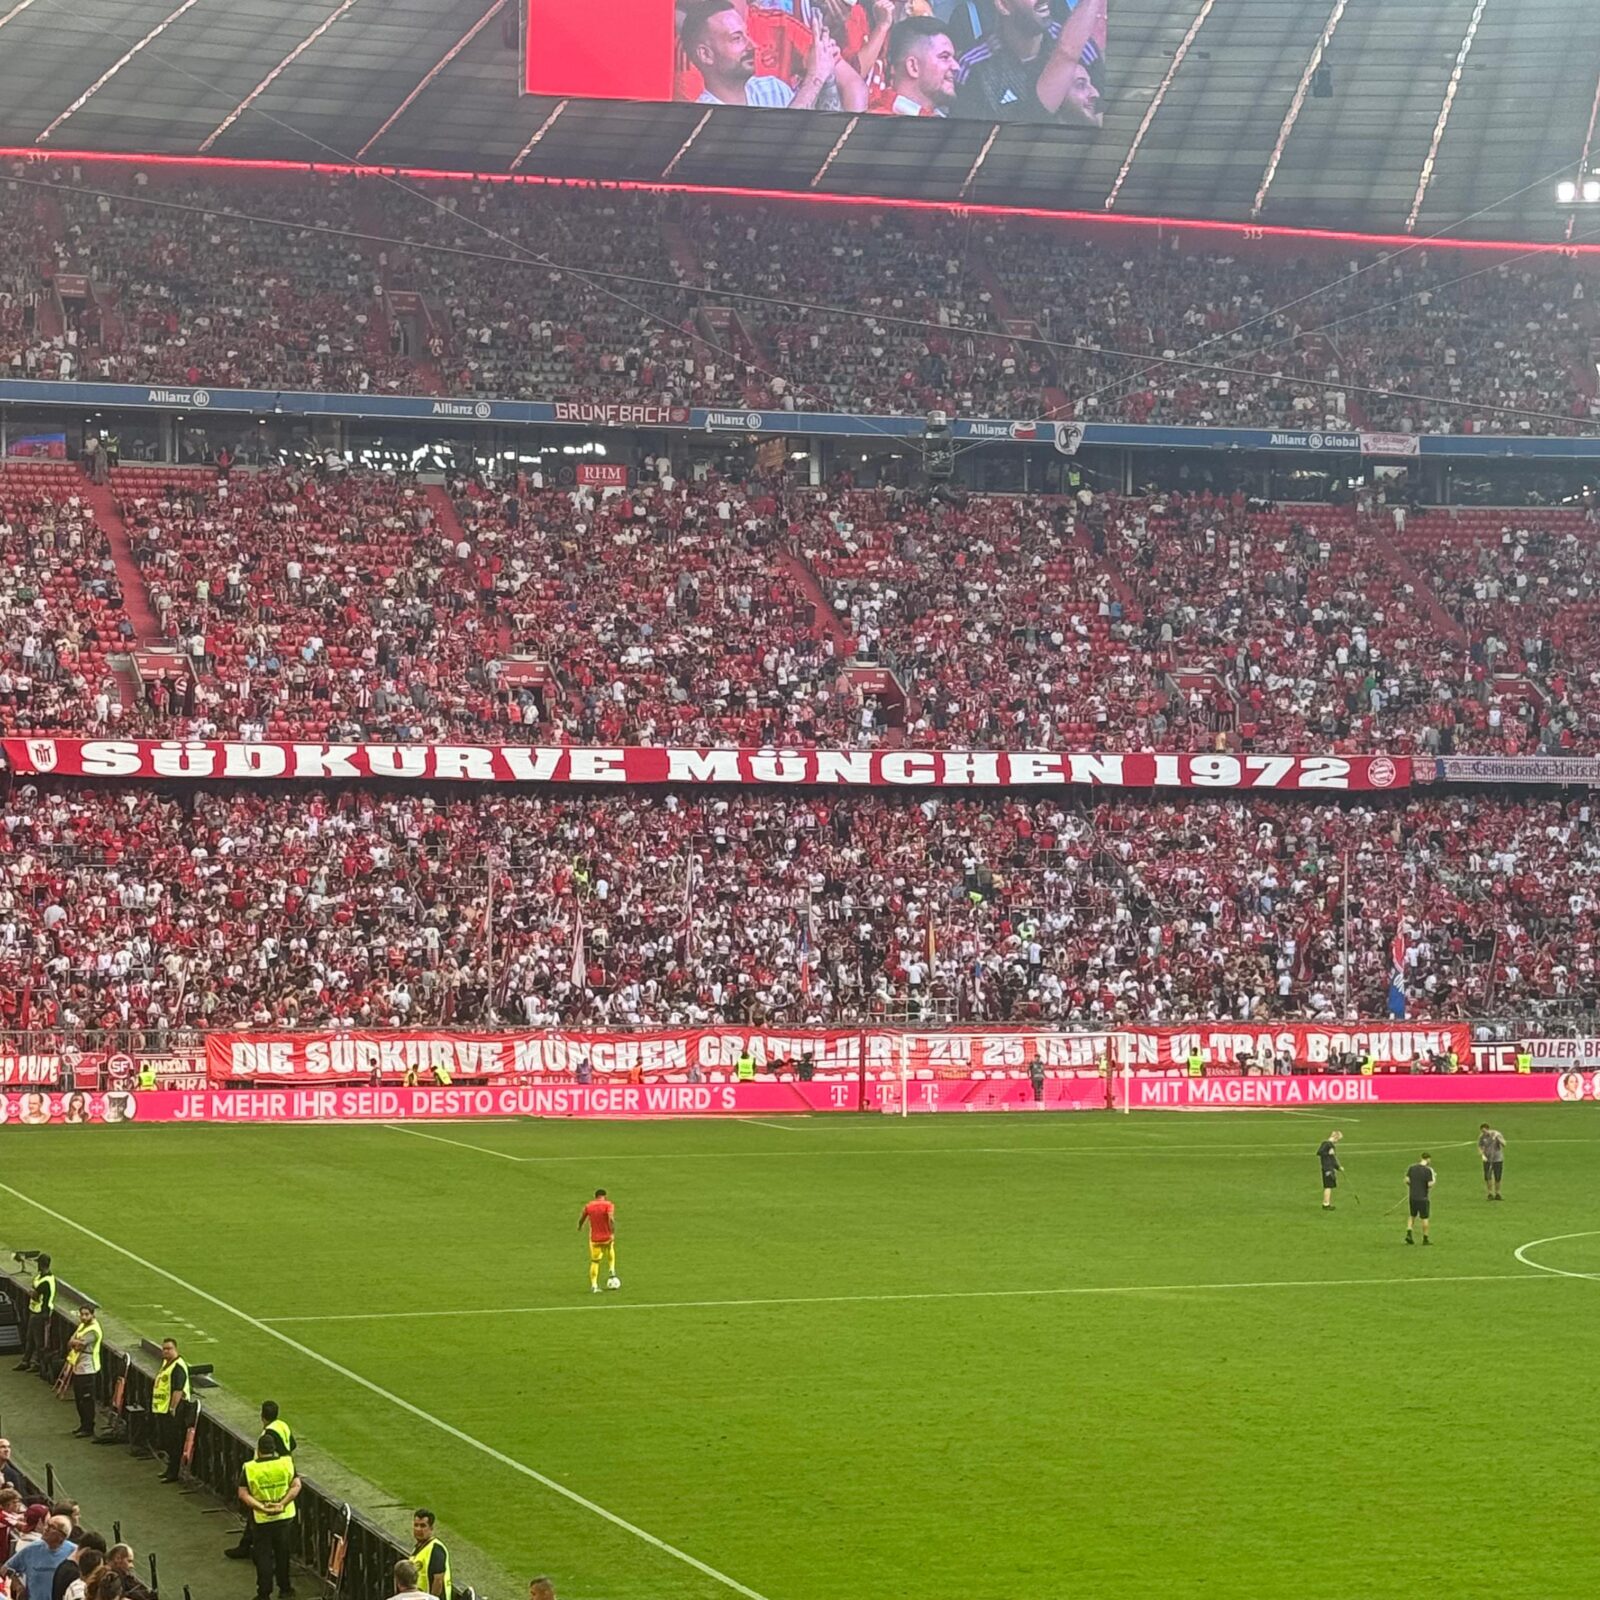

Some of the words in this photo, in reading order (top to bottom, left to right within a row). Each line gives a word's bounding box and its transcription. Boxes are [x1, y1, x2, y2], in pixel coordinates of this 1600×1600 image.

[148, 390, 191, 403] Allianz
[432, 402, 473, 416] Allianz
[706, 412, 745, 426] Allianz
[969, 423, 1008, 436] Allianz
[1270, 434, 1307, 447] Allianz
[1324, 434, 1359, 448] Global
[584, 466, 621, 480] RHM
[80, 741, 627, 781] SÜDKURVE
[667, 750, 1124, 785] MÜNCHEN
[1154, 755, 1350, 788] 1972
[231, 1041, 295, 1075] DIE
[305, 1035, 504, 1074] SÜDKURVE
[513, 1034, 688, 1073] MÜNCHEN
[982, 1036, 1025, 1066] 25
[1169, 1032, 1297, 1064] ULTRAS
[1306, 1031, 1452, 1063] BOCHUM!
[1527, 1041, 1576, 1058] ADLER
[18, 1055, 60, 1083] PRIDE
[112, 1060, 130, 1073] SF
[174, 1094, 205, 1118] JE
[212, 1094, 286, 1118] MEHR
[293, 1092, 337, 1117] IHR
[342, 1091, 406, 1117] SEID,
[412, 1089, 494, 1115] DESTO
[499, 1084, 640, 1113] GÜNSTIGER
[830, 1084, 849, 1107] T
[921, 1083, 939, 1106] T
[1141, 1082, 1183, 1103] MIT
[1188, 1079, 1302, 1103] MAGENTA
[1308, 1079, 1379, 1101] MOBIL
